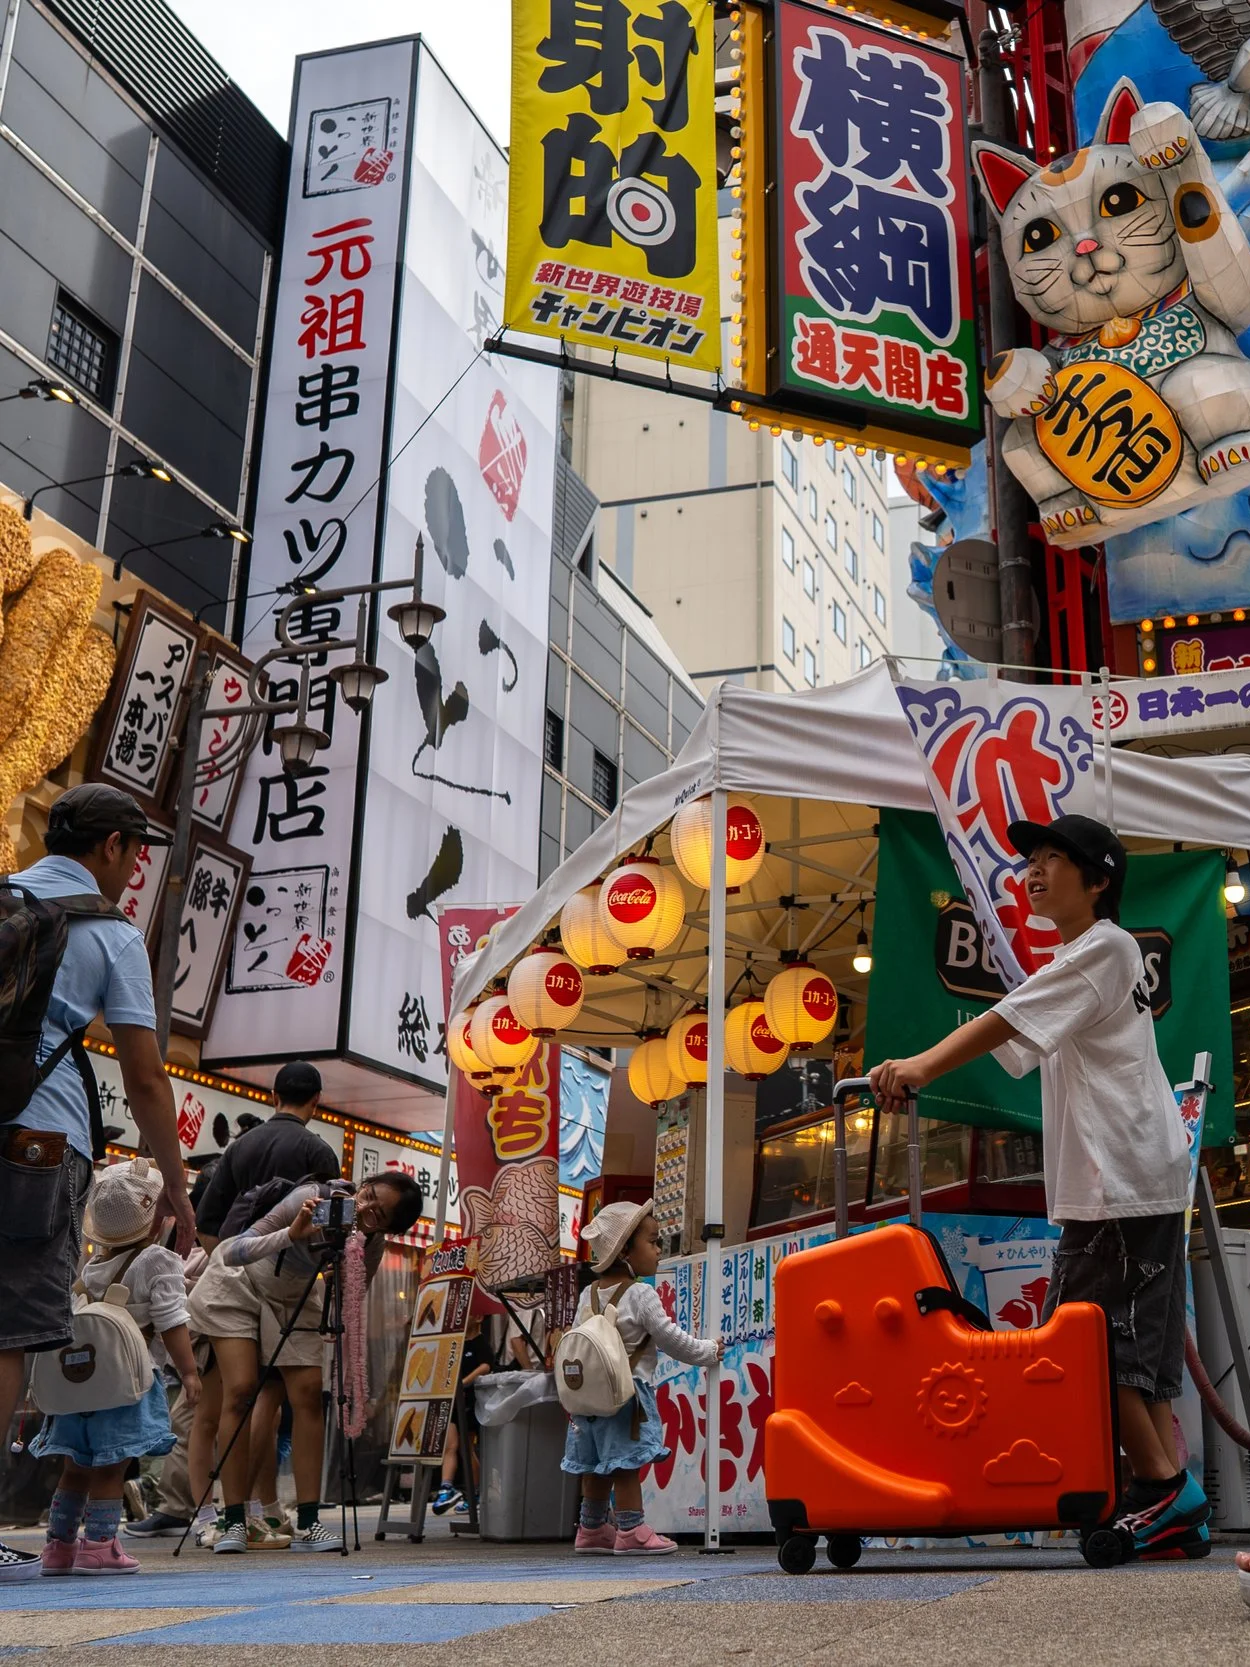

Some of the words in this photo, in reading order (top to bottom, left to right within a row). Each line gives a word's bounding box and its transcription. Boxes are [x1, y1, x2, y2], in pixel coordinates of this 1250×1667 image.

[798, 33, 954, 340] 横綱
[531, 291, 705, 354] チャンピオン
[534, 261, 704, 319] 新世界遊技場
[798, 323, 966, 414] 通天閣店
[137, 643, 186, 774] アスパラ
[609, 889, 655, 906] Coca-Cola
[721, 1258, 734, 1333] みぞれ
[739, 1250, 750, 1331] ブルーハワイ
[753, 1256, 765, 1324] 抹茶
